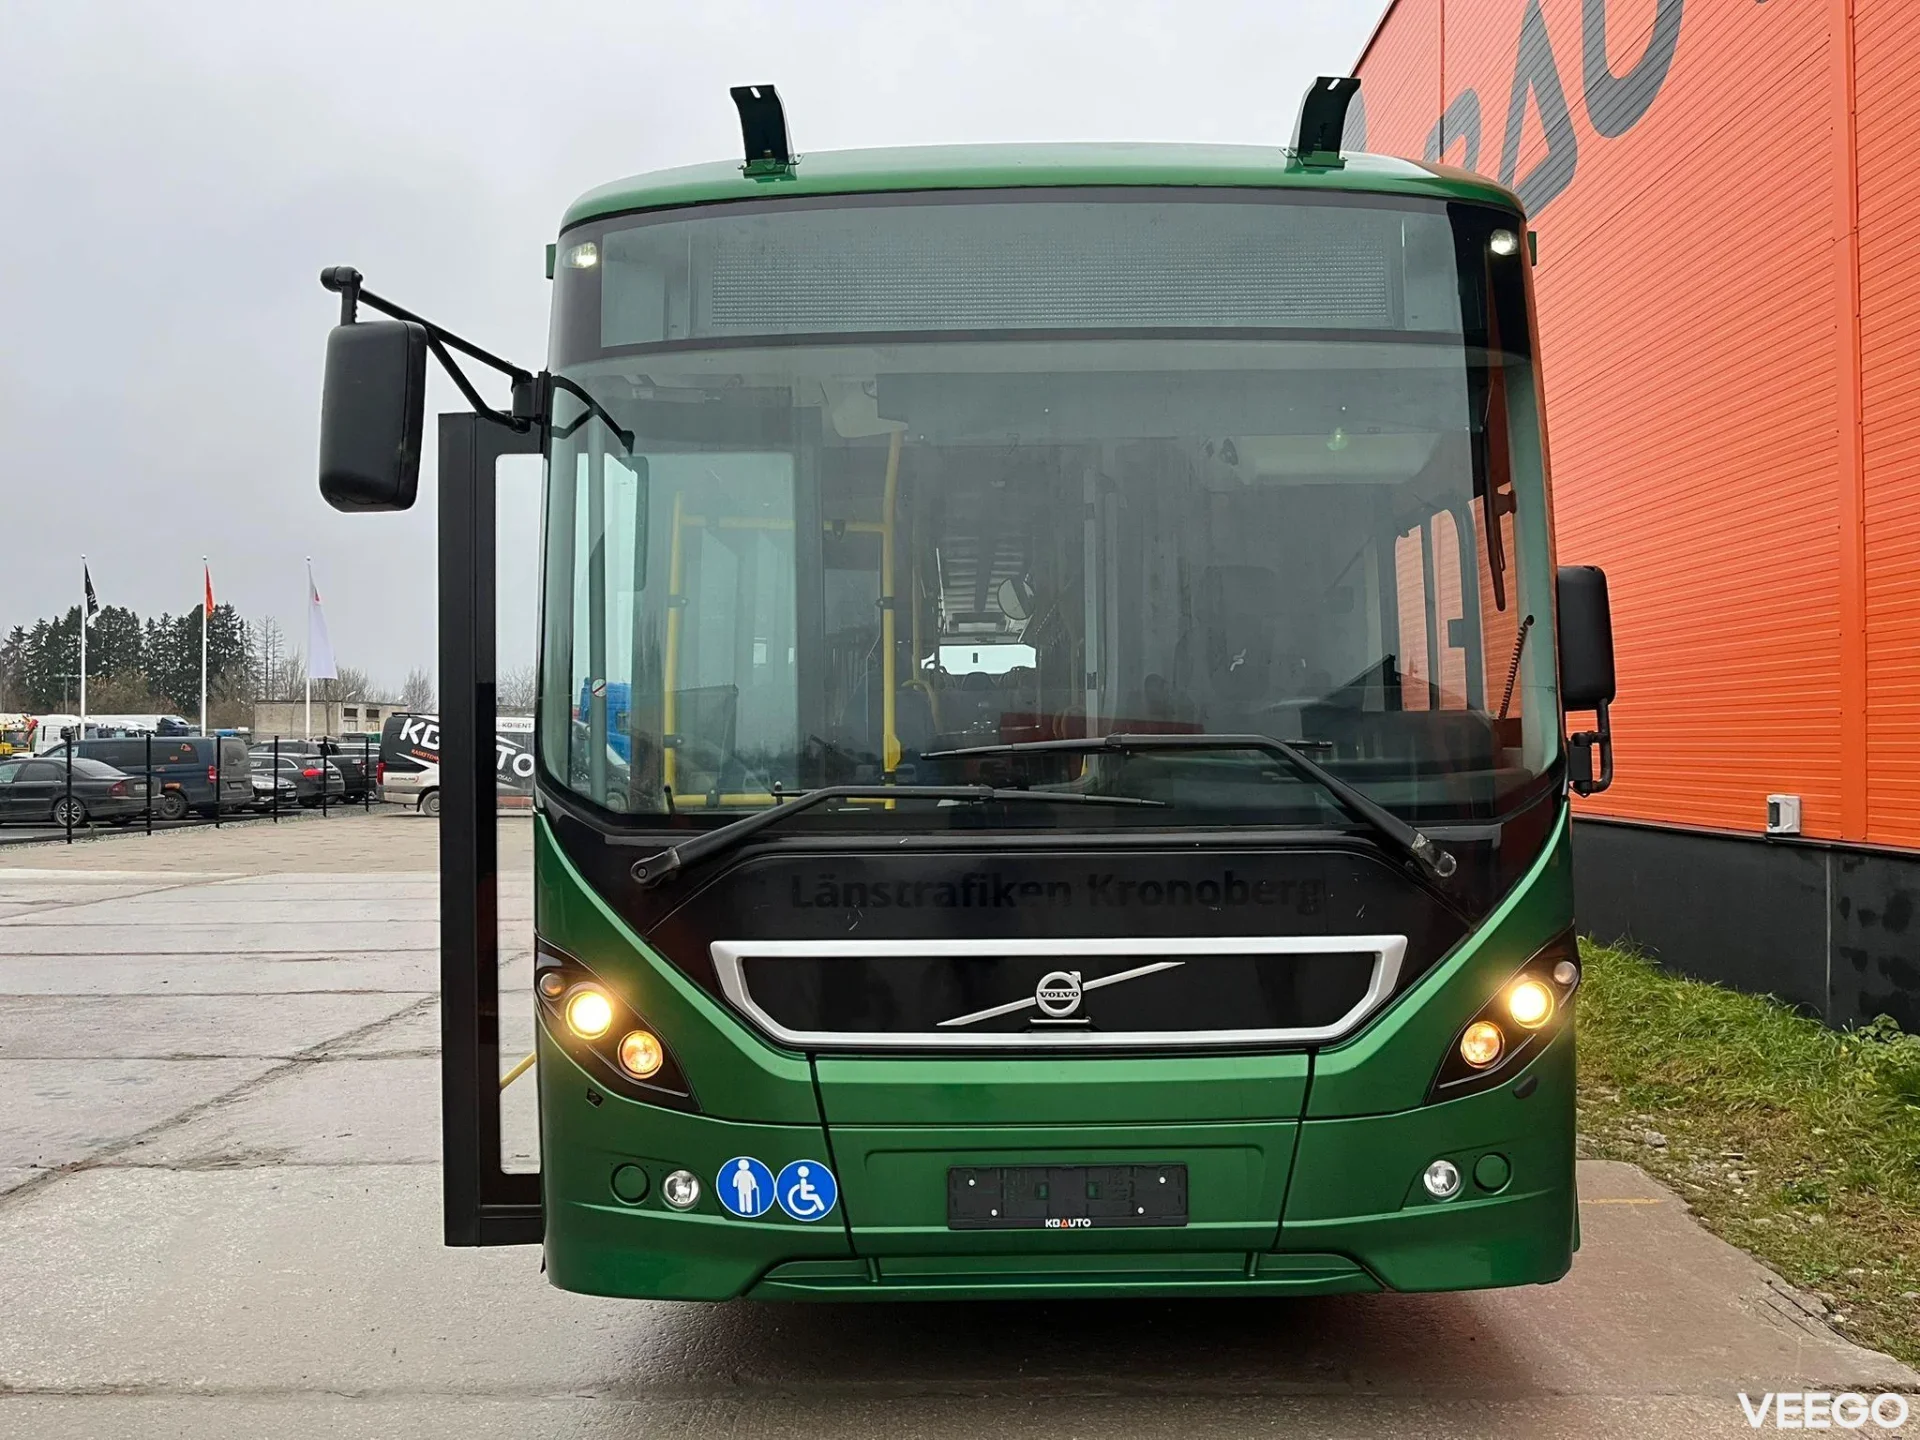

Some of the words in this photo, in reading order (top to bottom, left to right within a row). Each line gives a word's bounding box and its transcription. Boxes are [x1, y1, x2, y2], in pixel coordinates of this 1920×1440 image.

[791, 873, 1072, 908] Länstrafiken
[1087, 871, 1323, 916] Kronoberg
[1039, 991, 1080, 999] VOLVO
[1044, 1218, 1092, 1228] KBAUTO
